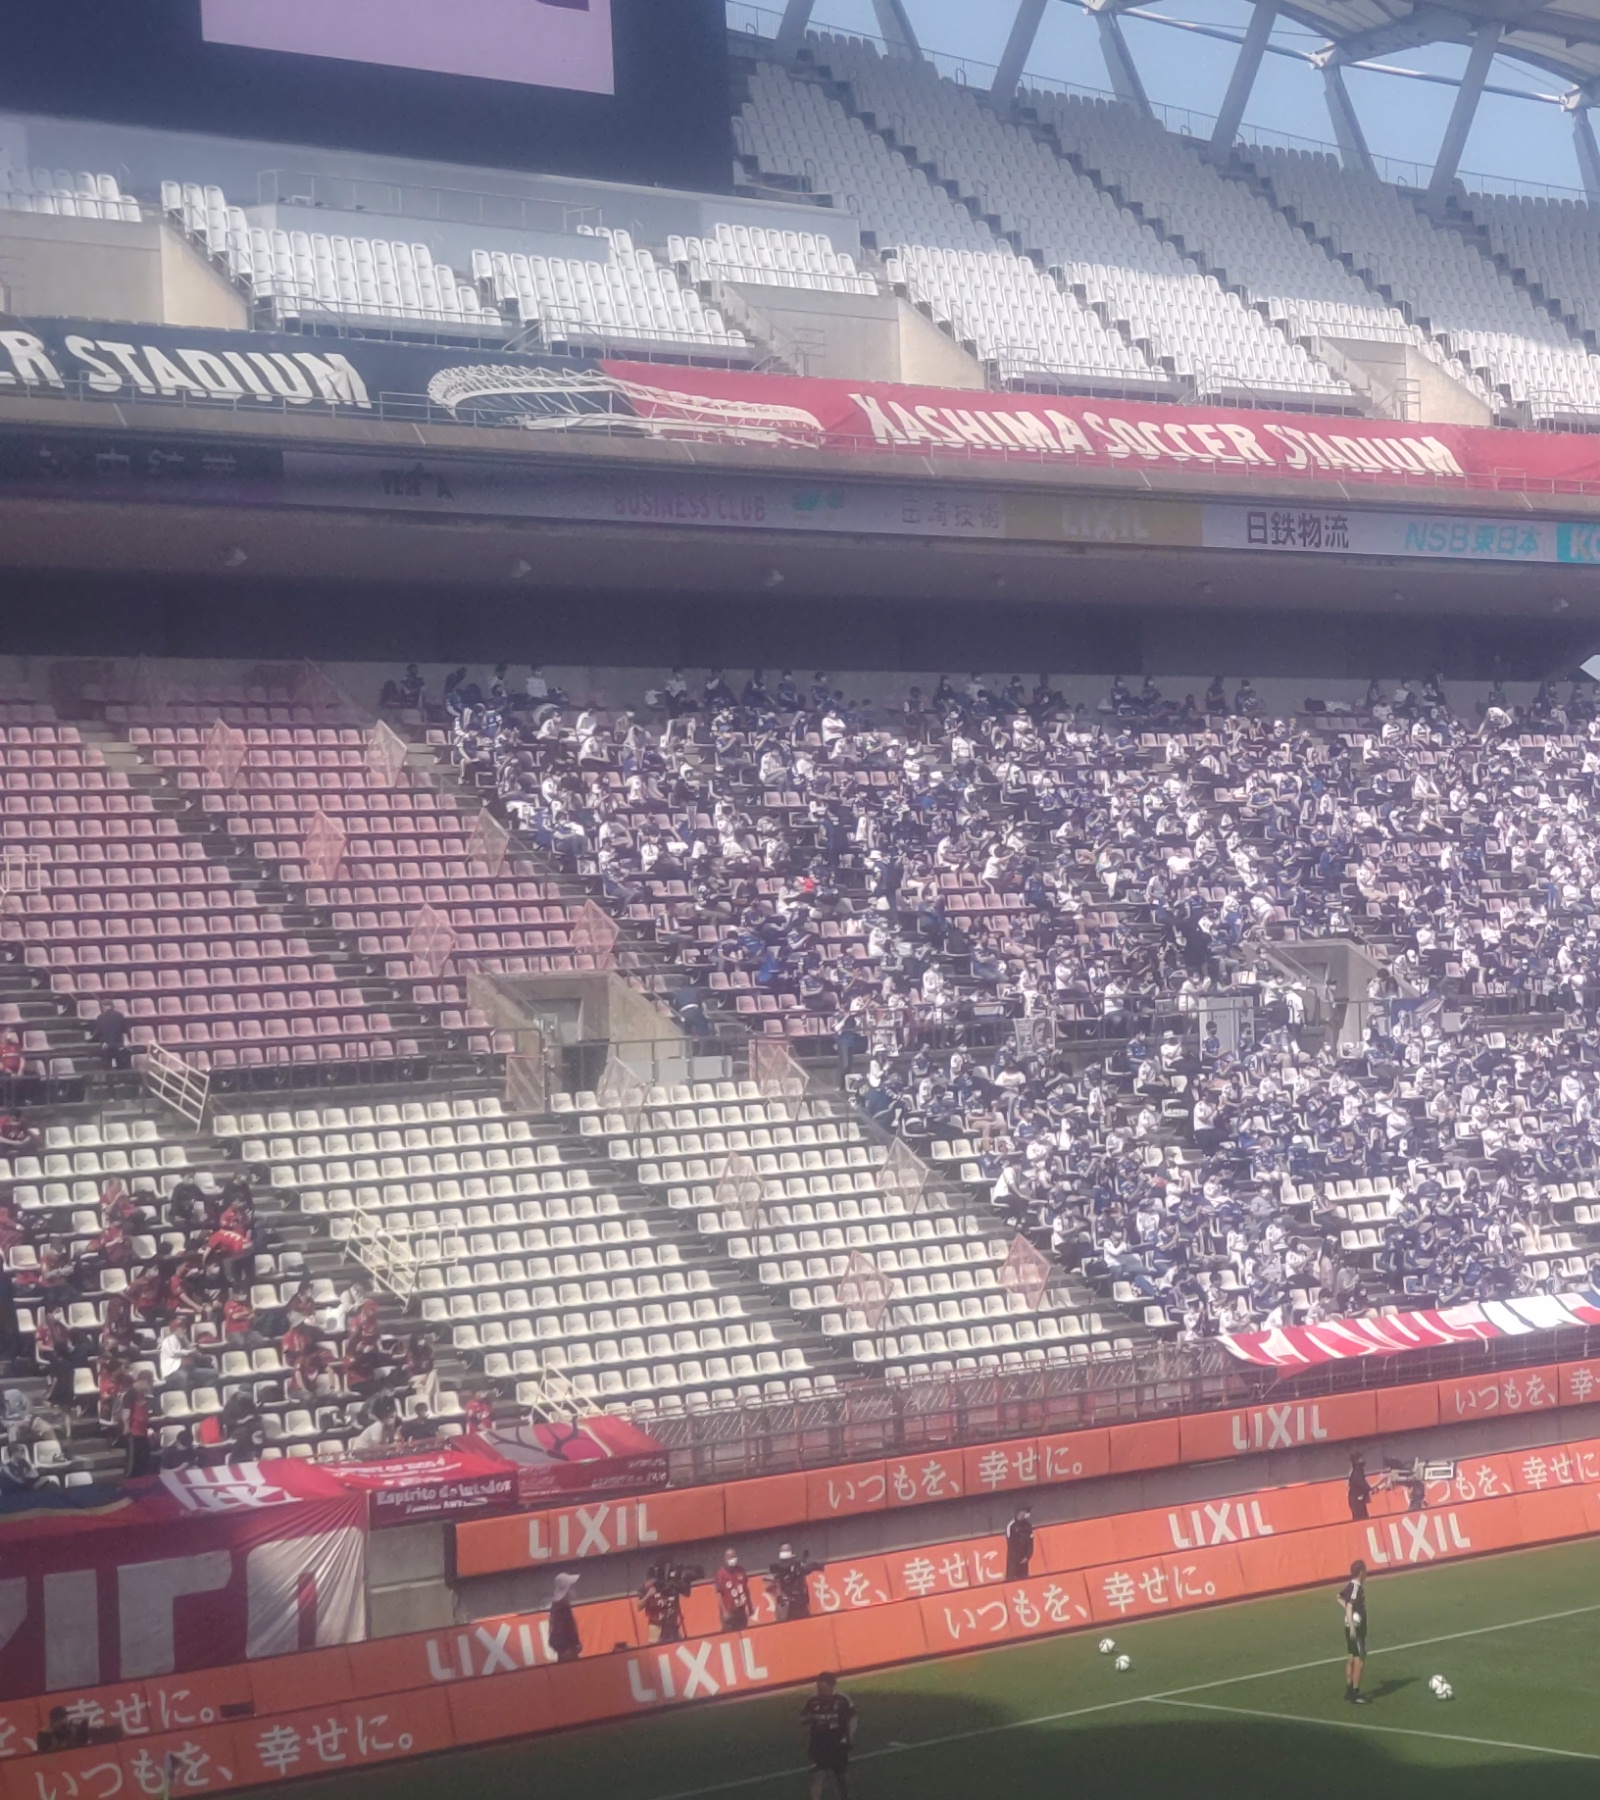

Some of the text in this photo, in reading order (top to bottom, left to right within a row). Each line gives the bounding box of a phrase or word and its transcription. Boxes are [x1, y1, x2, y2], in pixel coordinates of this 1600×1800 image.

[0, 329, 372, 409] R STADIUM
[849, 393, 1467, 477] KASHIMA SOCCER STADIUM
[1246, 510, 1348, 550] 日鉄物流
[1405, 522, 1541, 555] NSB東日本
[1232, 1404, 1328, 1451] LIXIL
[529, 1502, 657, 1559] LIXIL
[1168, 1500, 1274, 1550] LIXIL
[1366, 1511, 1471, 1564] LIXIL
[628, 1636, 768, 1703] LIXIL
